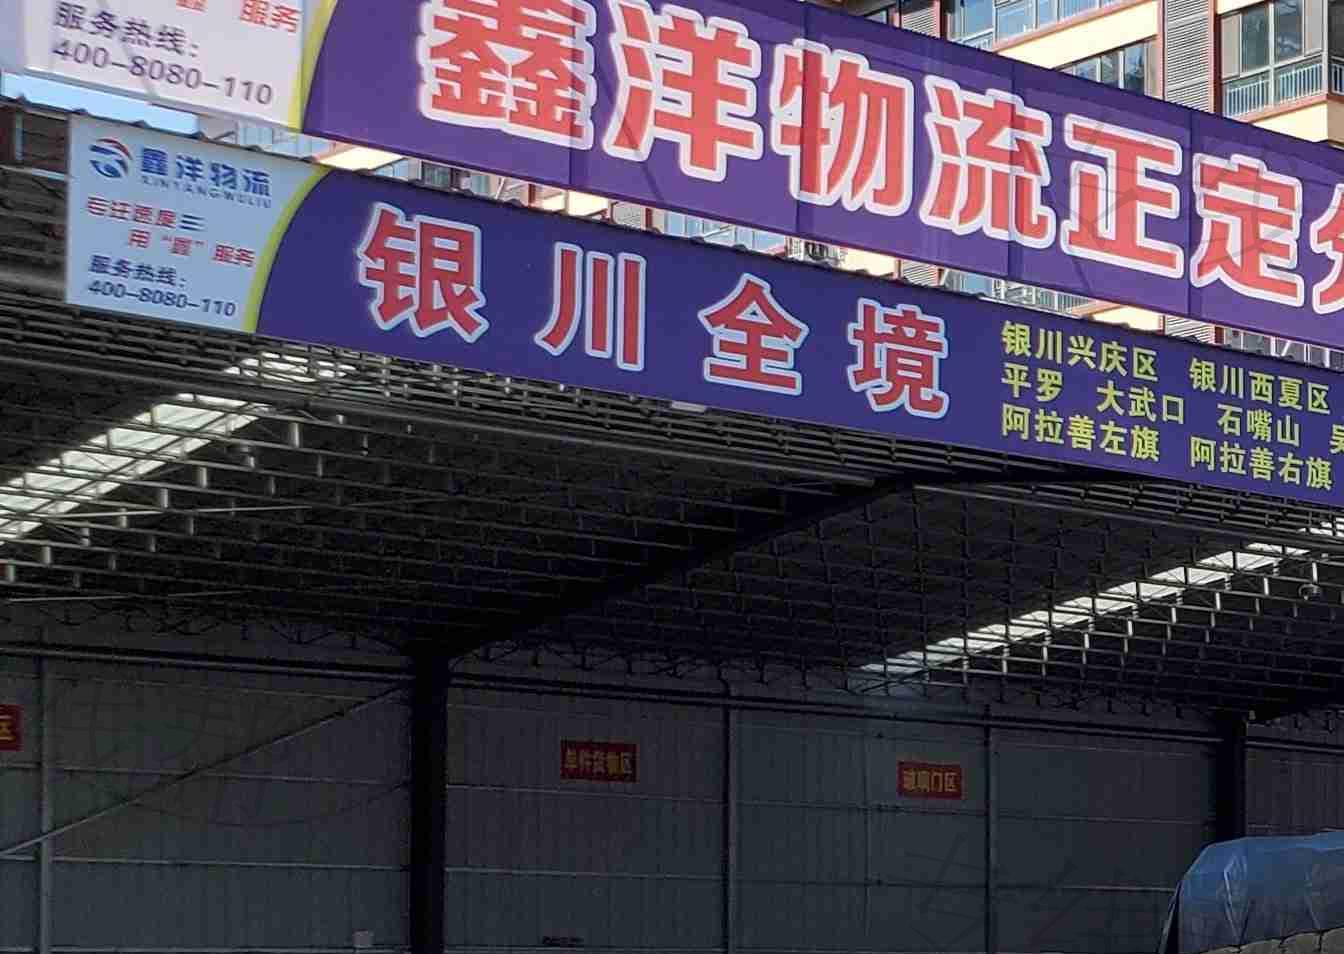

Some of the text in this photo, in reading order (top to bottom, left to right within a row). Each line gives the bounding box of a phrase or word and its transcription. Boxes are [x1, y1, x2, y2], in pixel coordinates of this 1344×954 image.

[52, 40, 273, 105] 400-8080-110
[140, 147, 272, 197] 鑫洋物流
[88, 280, 237, 317] 400-8080-110
[358, 201, 950, 419] 银川全境
[1001, 319, 1159, 382] 银川兴庆区
[1189, 356, 1331, 415] 银川西夏区
[1001, 361, 1064, 402] 平罗
[1096, 380, 1185, 425] 大武口
[1217, 403, 1300, 450] 石嘴山
[1001, 403, 1333, 491] 阿拉善左旗 阿拉善右旗
